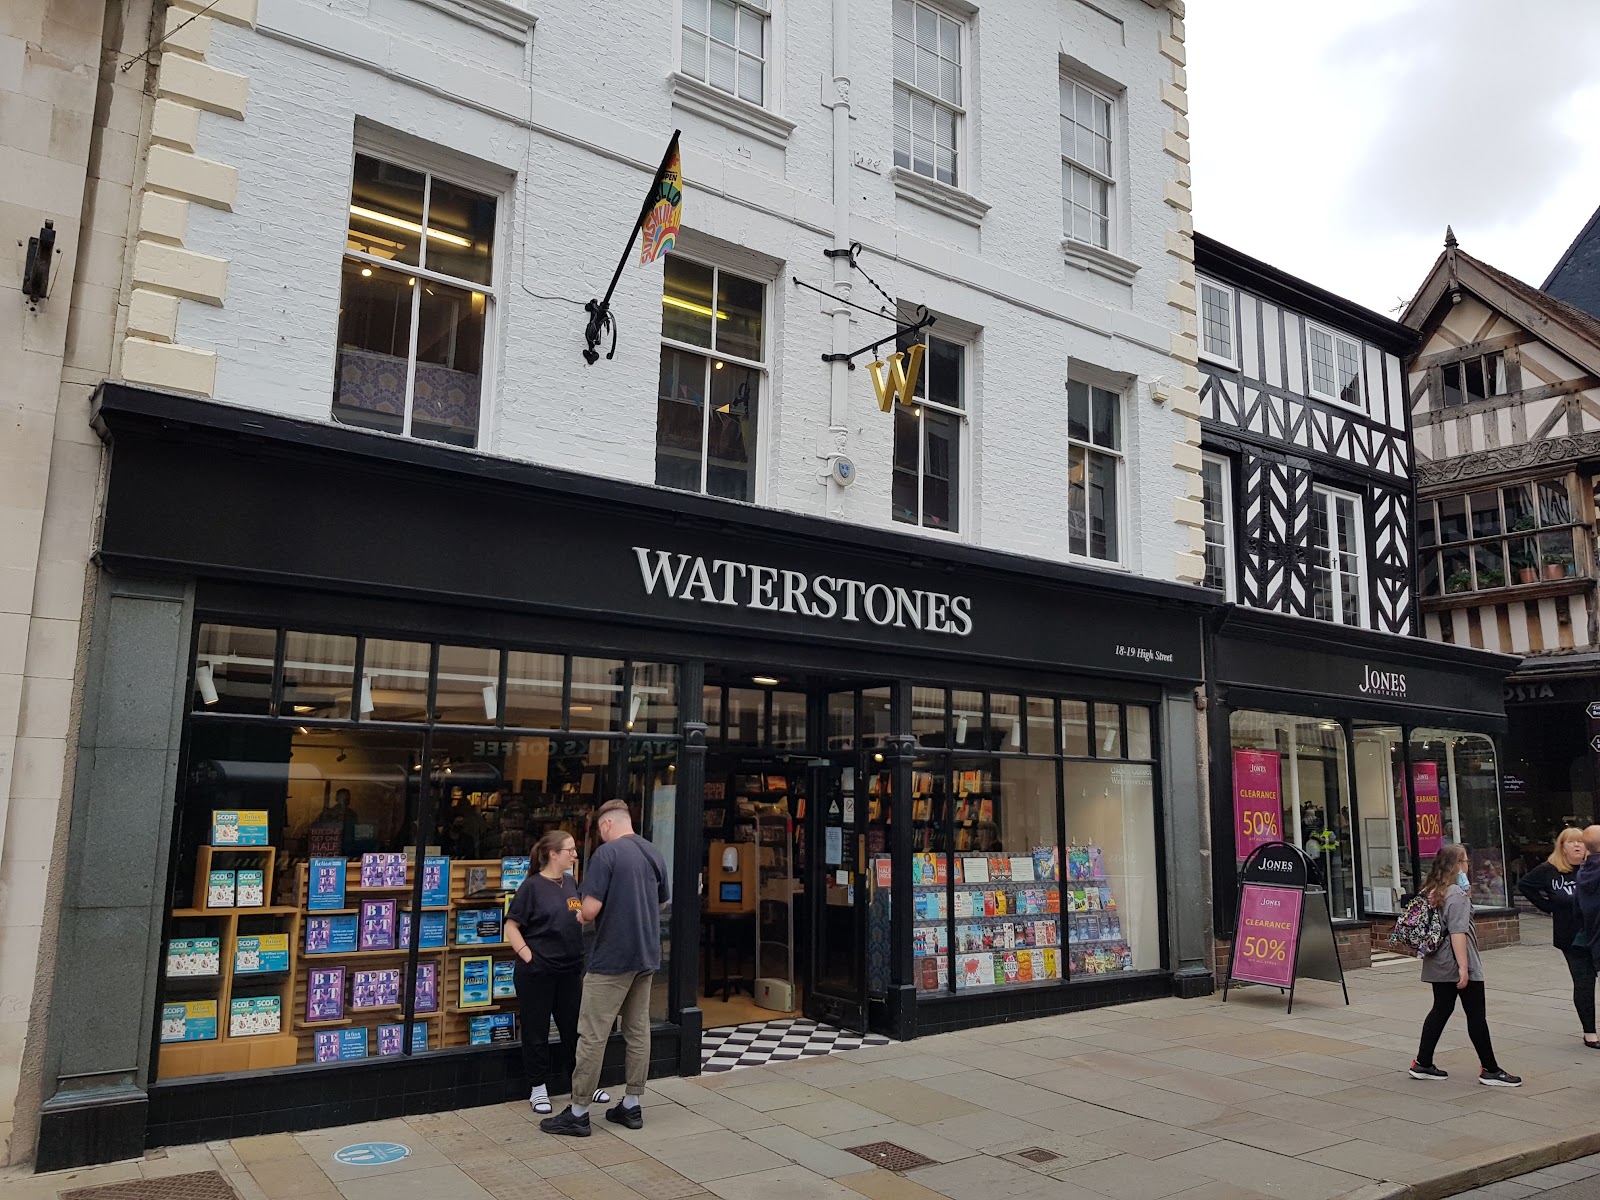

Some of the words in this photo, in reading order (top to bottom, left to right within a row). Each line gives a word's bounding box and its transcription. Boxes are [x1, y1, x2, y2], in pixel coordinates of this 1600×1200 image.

[664, 173, 677, 181] PEN
[865, 344, 927, 413] W
[632, 547, 973, 636] WATERSTONES
[1115, 645, 1136, 657] 18-19
[1137, 648, 1154, 662] High
[1155, 650, 1173, 662] Street
[1503, 684, 1554, 702] OSTA
[1240, 789, 1277, 800] CLEARANCE
[1415, 795, 1438, 803] EARANCE
[1243, 811, 1277, 836] 50%
[312, 842, 339, 851] HALF
[1245, 918, 1291, 930] CLEARANCE
[1243, 936, 1286, 961] 50%
